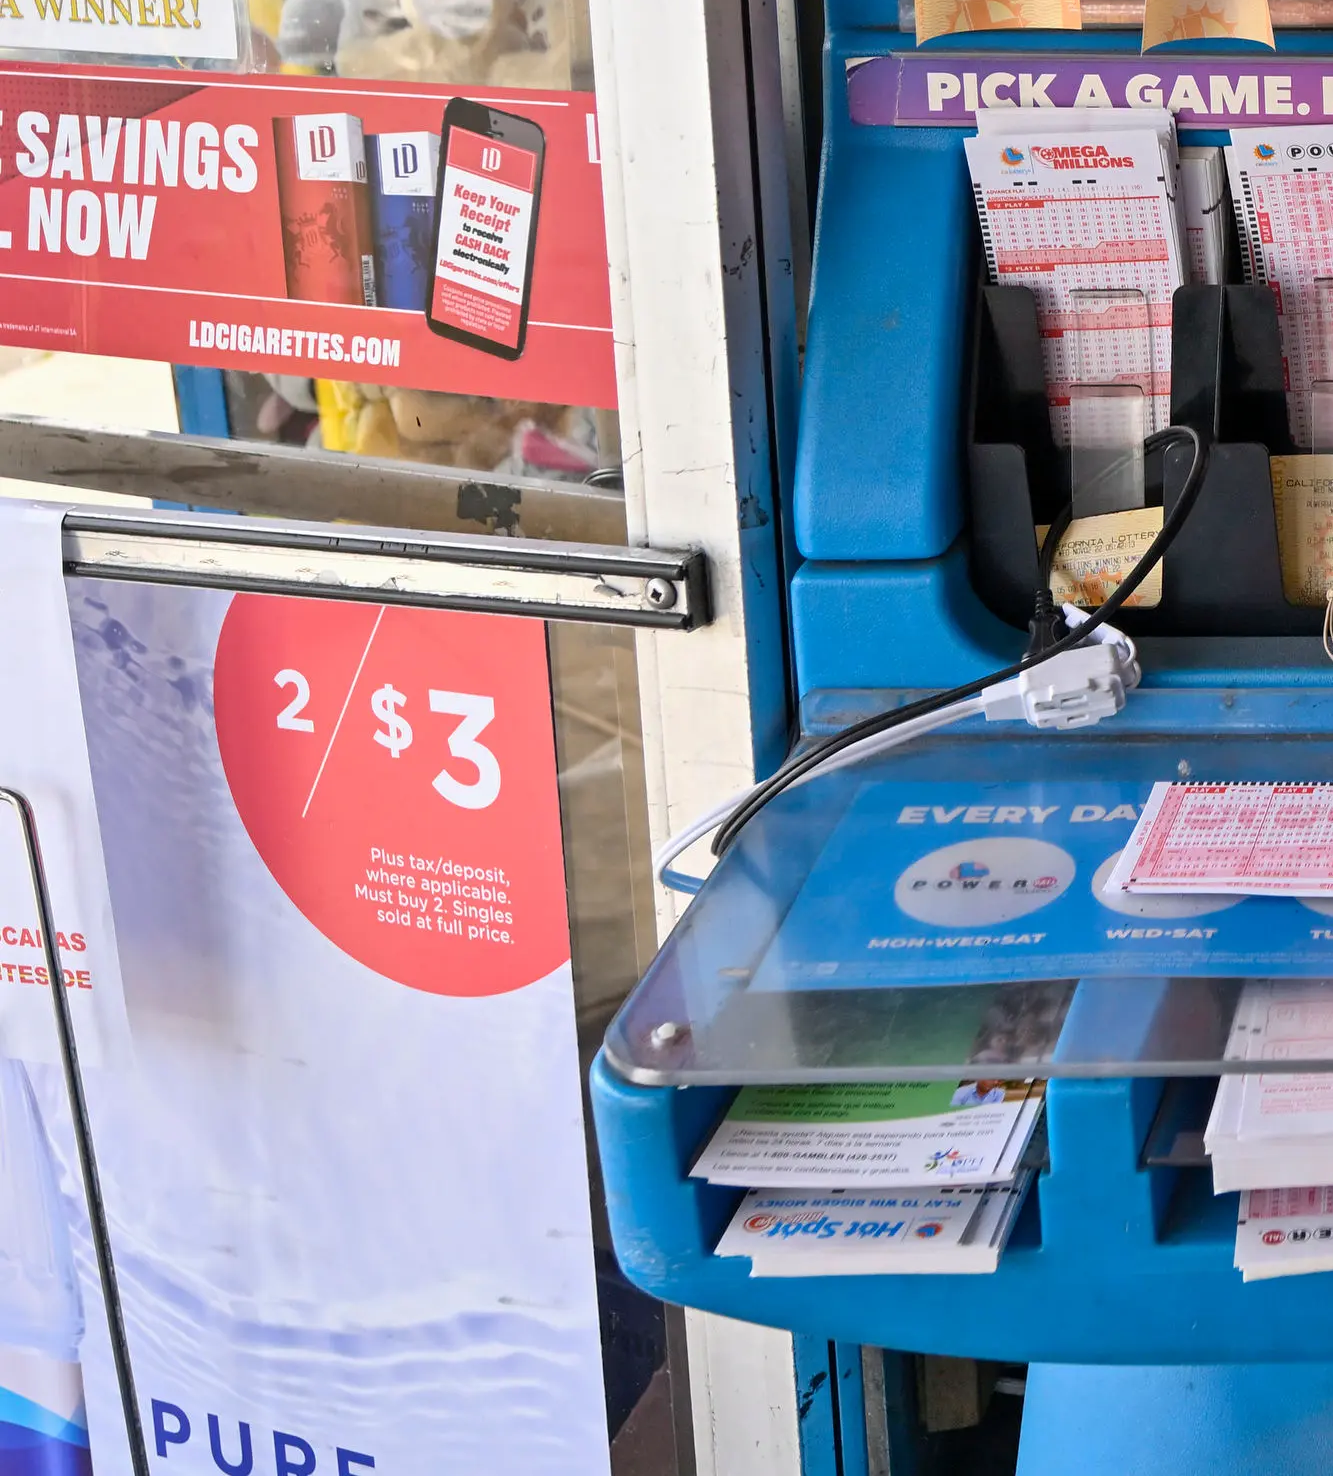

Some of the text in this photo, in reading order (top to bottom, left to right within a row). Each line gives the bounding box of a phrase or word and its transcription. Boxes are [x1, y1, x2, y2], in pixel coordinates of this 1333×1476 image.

[927, 72, 1056, 112] PICK
[1073, 74, 1112, 109] A
[1125, 74, 1311, 116] GAME.
[15, 111, 259, 193] SAVINGS
[309, 125, 336, 163] LD
[393, 143, 418, 178] LD
[481, 147, 501, 171] LD
[1051, 146, 1109, 157] MEGA
[1053, 157, 1134, 168] MILLIONS
[453, 183, 521, 217] Keep Your
[28, 187, 157, 261] NOW
[460, 204, 511, 233] Receipt
[455, 233, 511, 261] CASH BACK
[189, 321, 401, 367] LDCIGARETTES.COM
[274, 669, 315, 733] 2
[896, 806, 1059, 825] EVERY
[371, 847, 510, 887] Plus tax/deposit,
[366, 868, 512, 904] where applicable.
[355, 884, 513, 924] Must buy 2. Singles
[377, 909, 514, 944] sold at full price.
